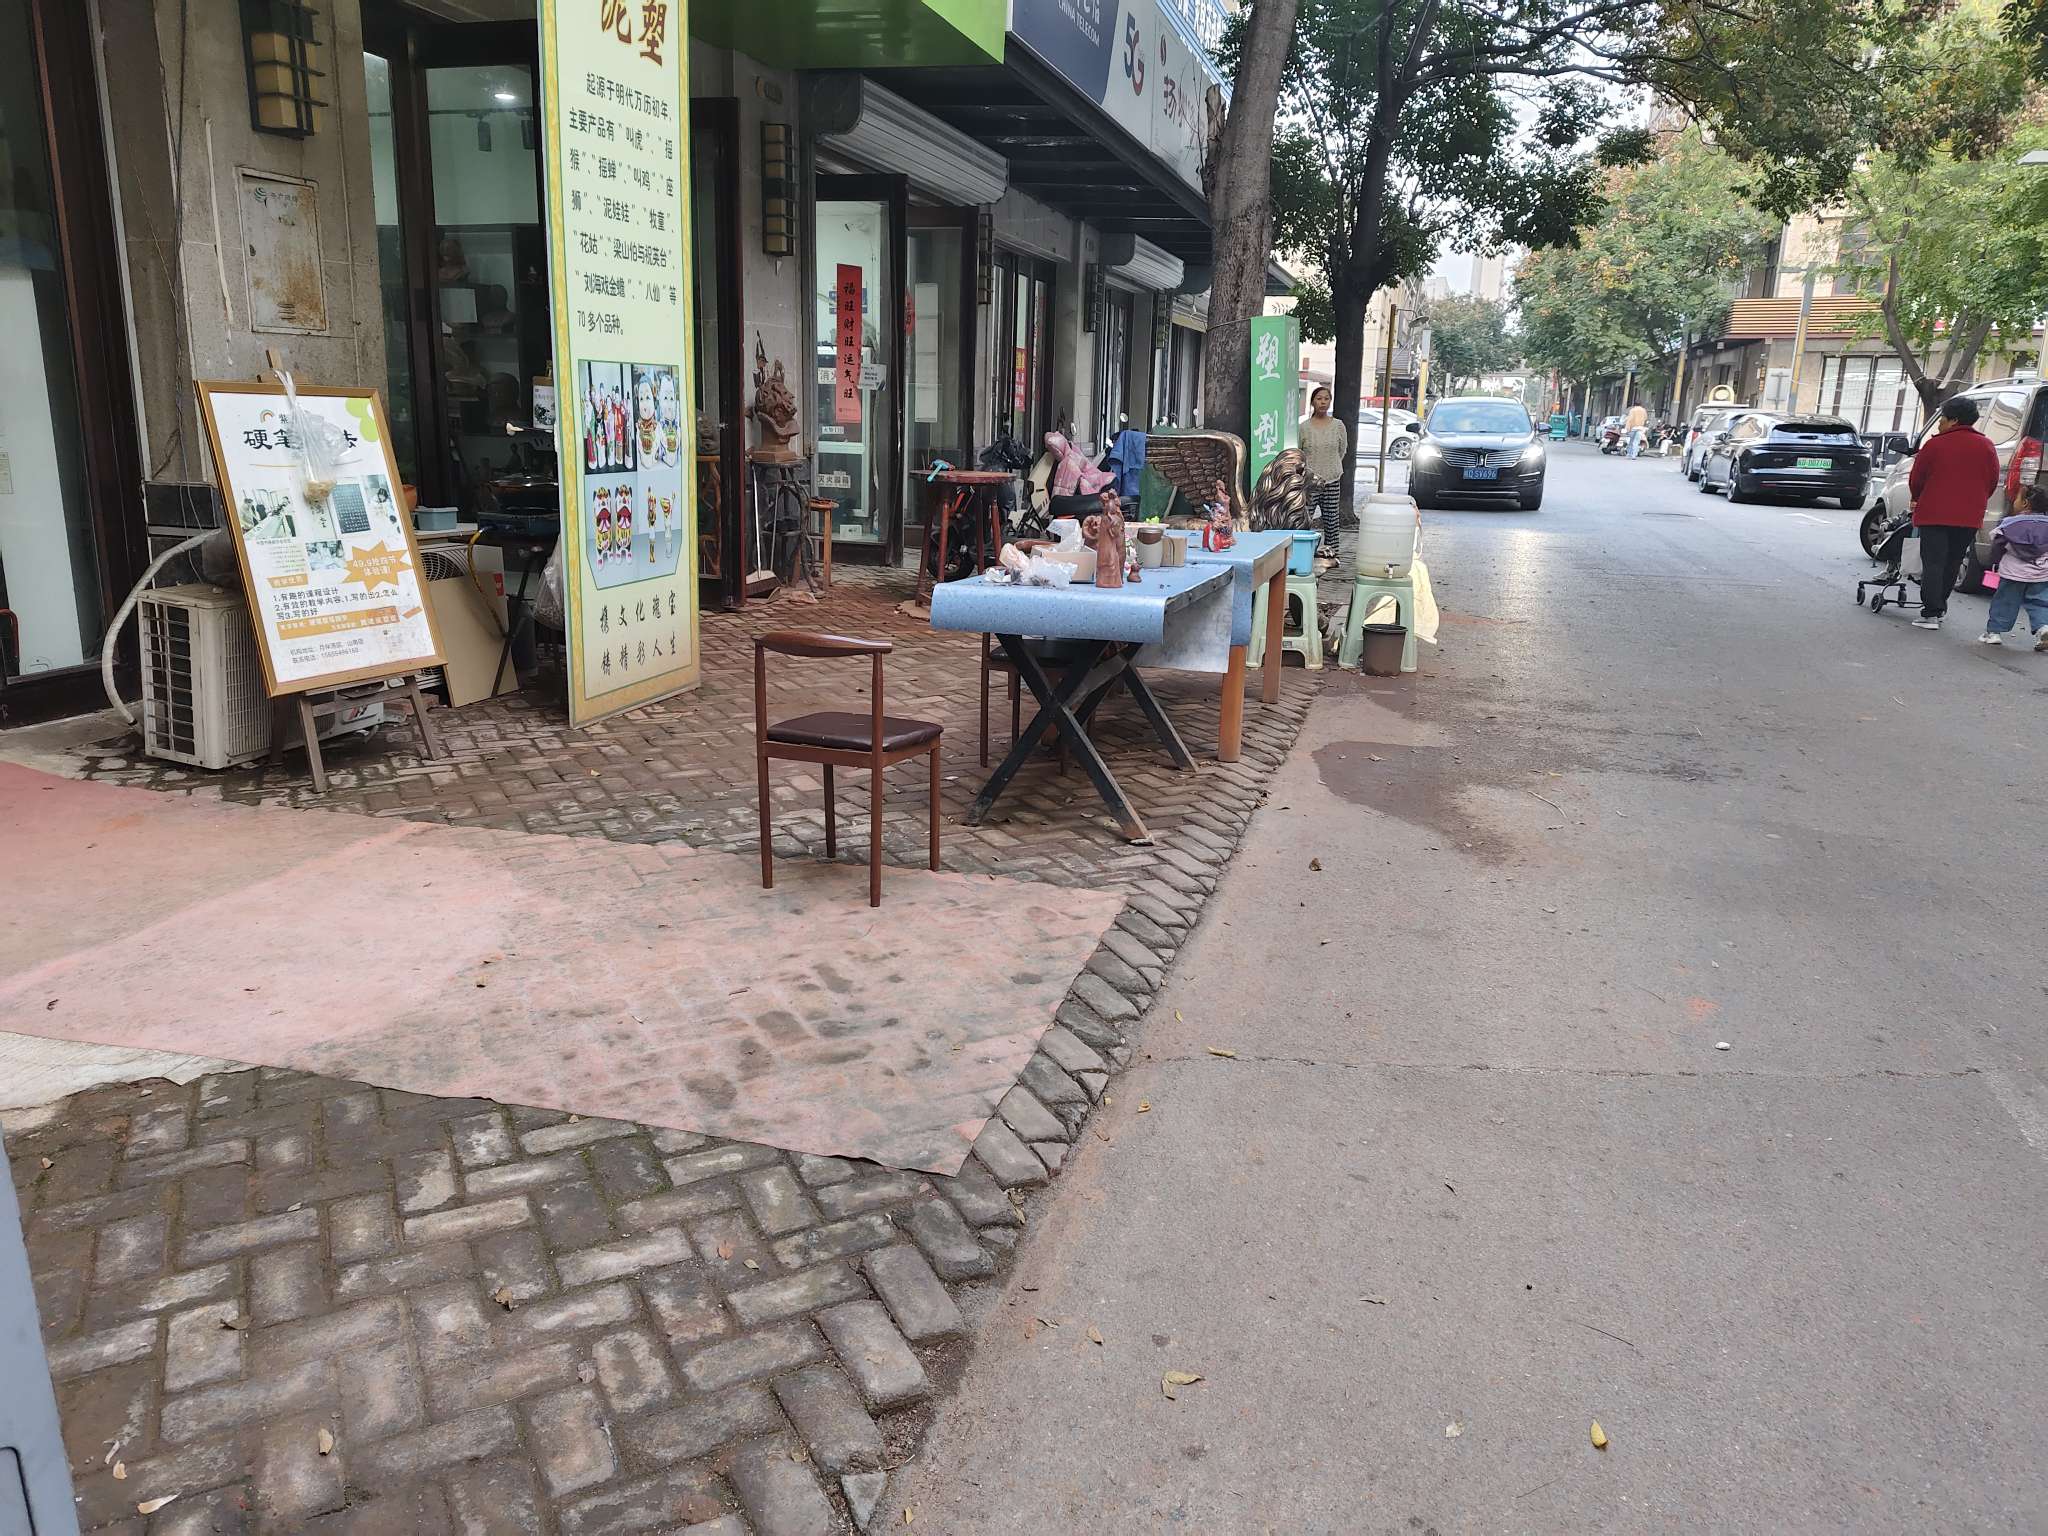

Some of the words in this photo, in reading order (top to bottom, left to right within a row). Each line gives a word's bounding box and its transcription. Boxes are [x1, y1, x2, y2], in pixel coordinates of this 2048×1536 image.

[1076, 11, 1100, 48] TELECOM
[1123, 11, 1145, 97] 5G
[842, 281, 856, 400] 福旺财旺运气旺
